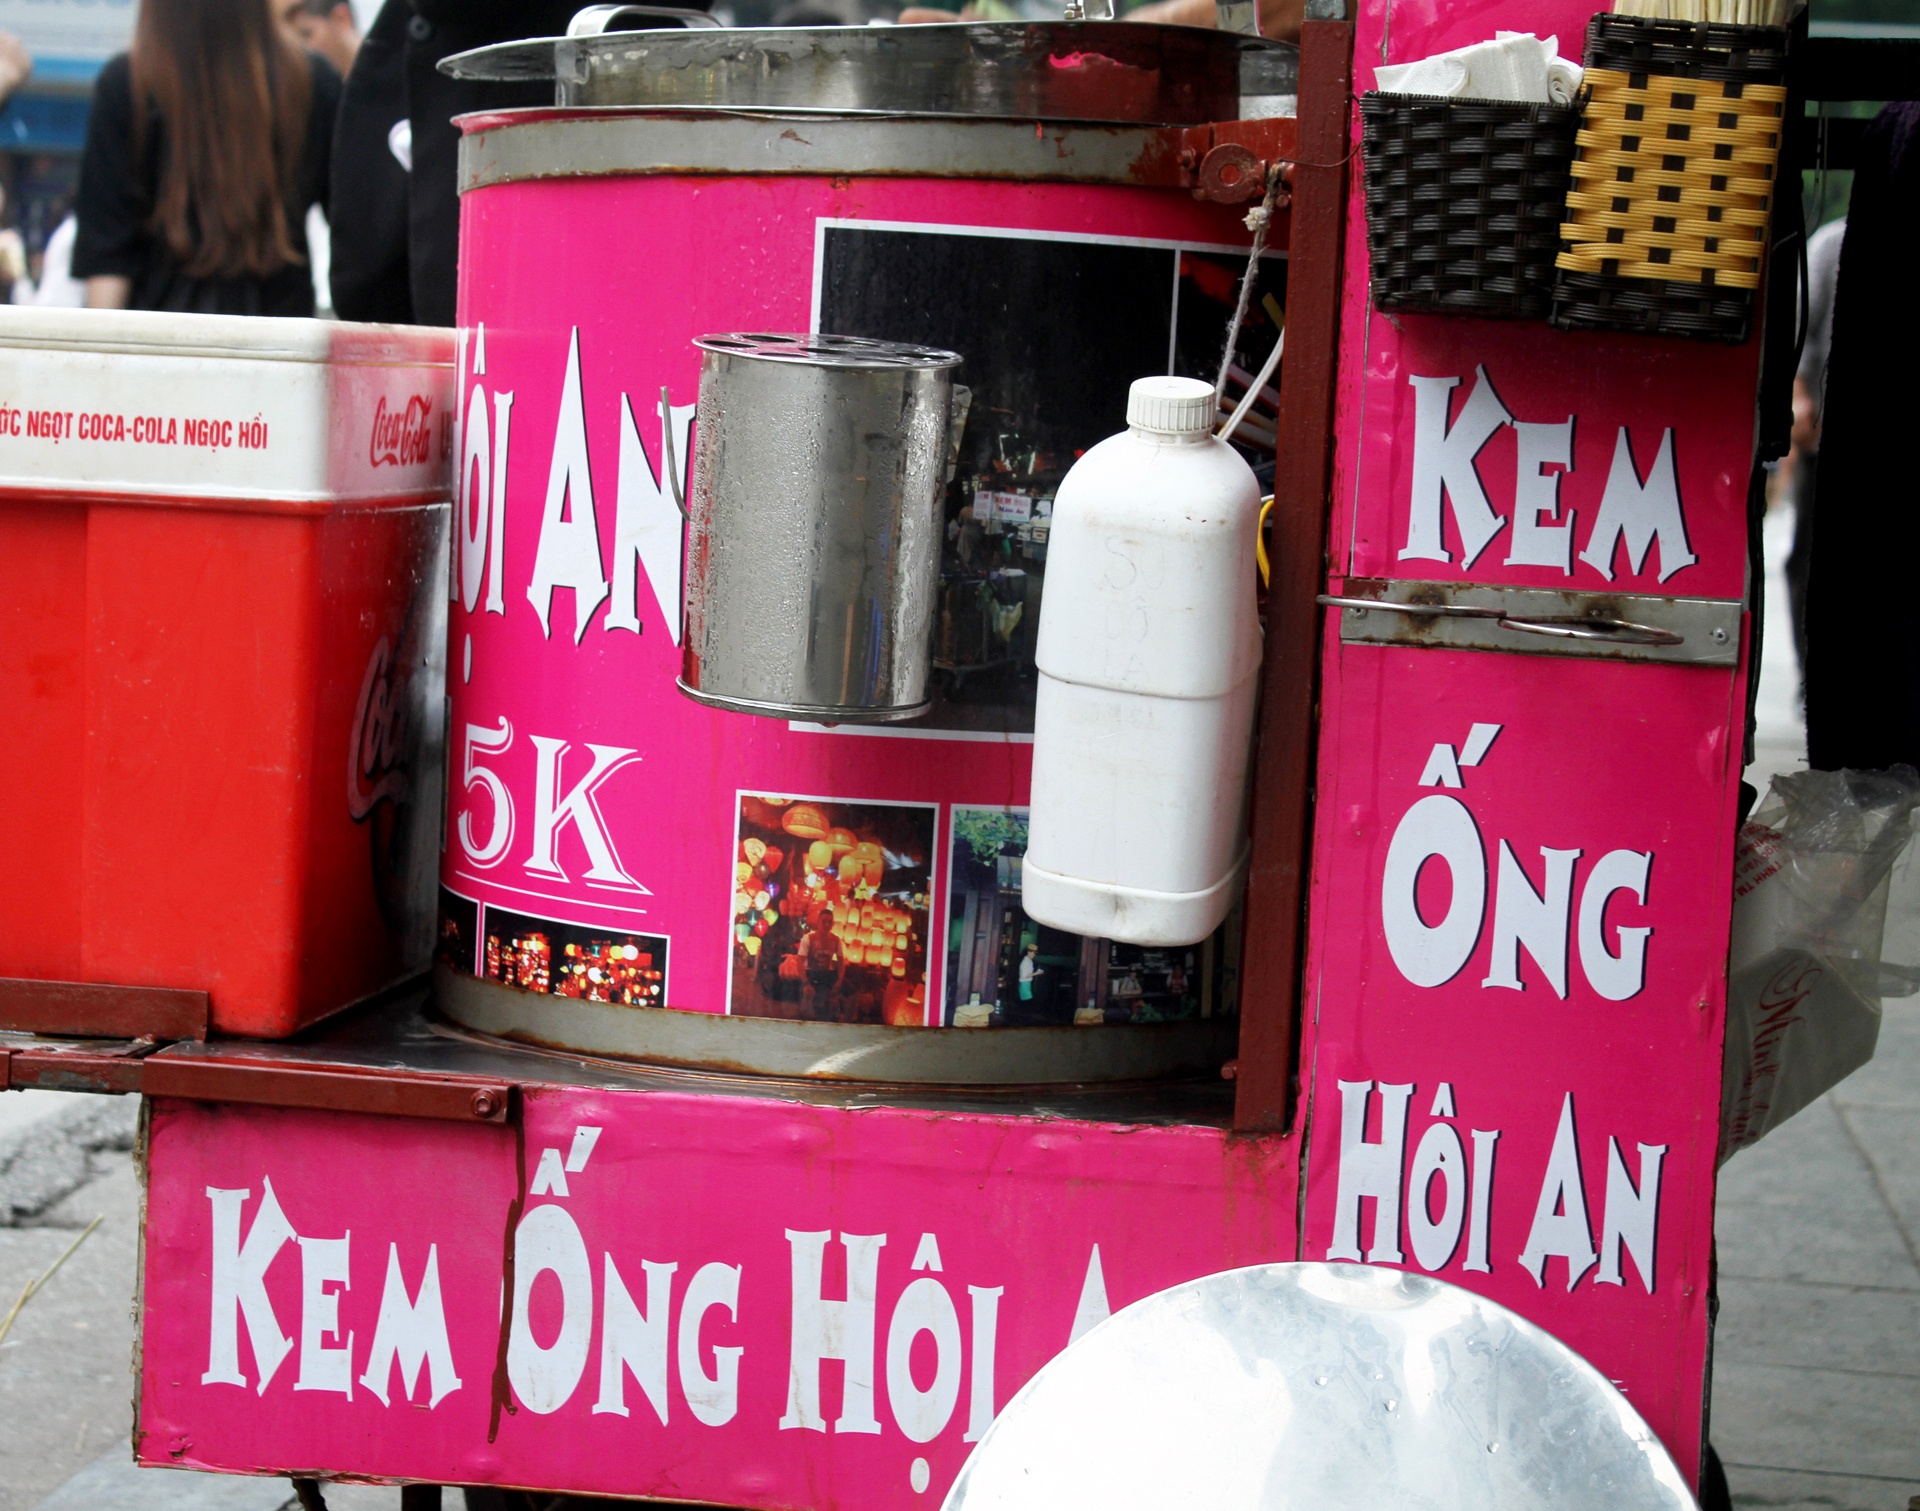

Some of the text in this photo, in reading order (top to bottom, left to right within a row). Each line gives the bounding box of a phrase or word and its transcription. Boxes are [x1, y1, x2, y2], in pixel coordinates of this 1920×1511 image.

[27, 411, 73, 444] NGỌT
[79, 413, 177, 444] COCA-COLA
[184, 418, 232, 452] NGỌC
[527, 325, 697, 647] AN
[1398, 363, 1699, 584] KEM
[458, 716, 654, 895] 5K
[1382, 723, 1654, 1001] ỐNG
[1518, 1091, 1670, 1295] AN
[201, 1126, 1004, 1494] KEM ỐNG HỘI
